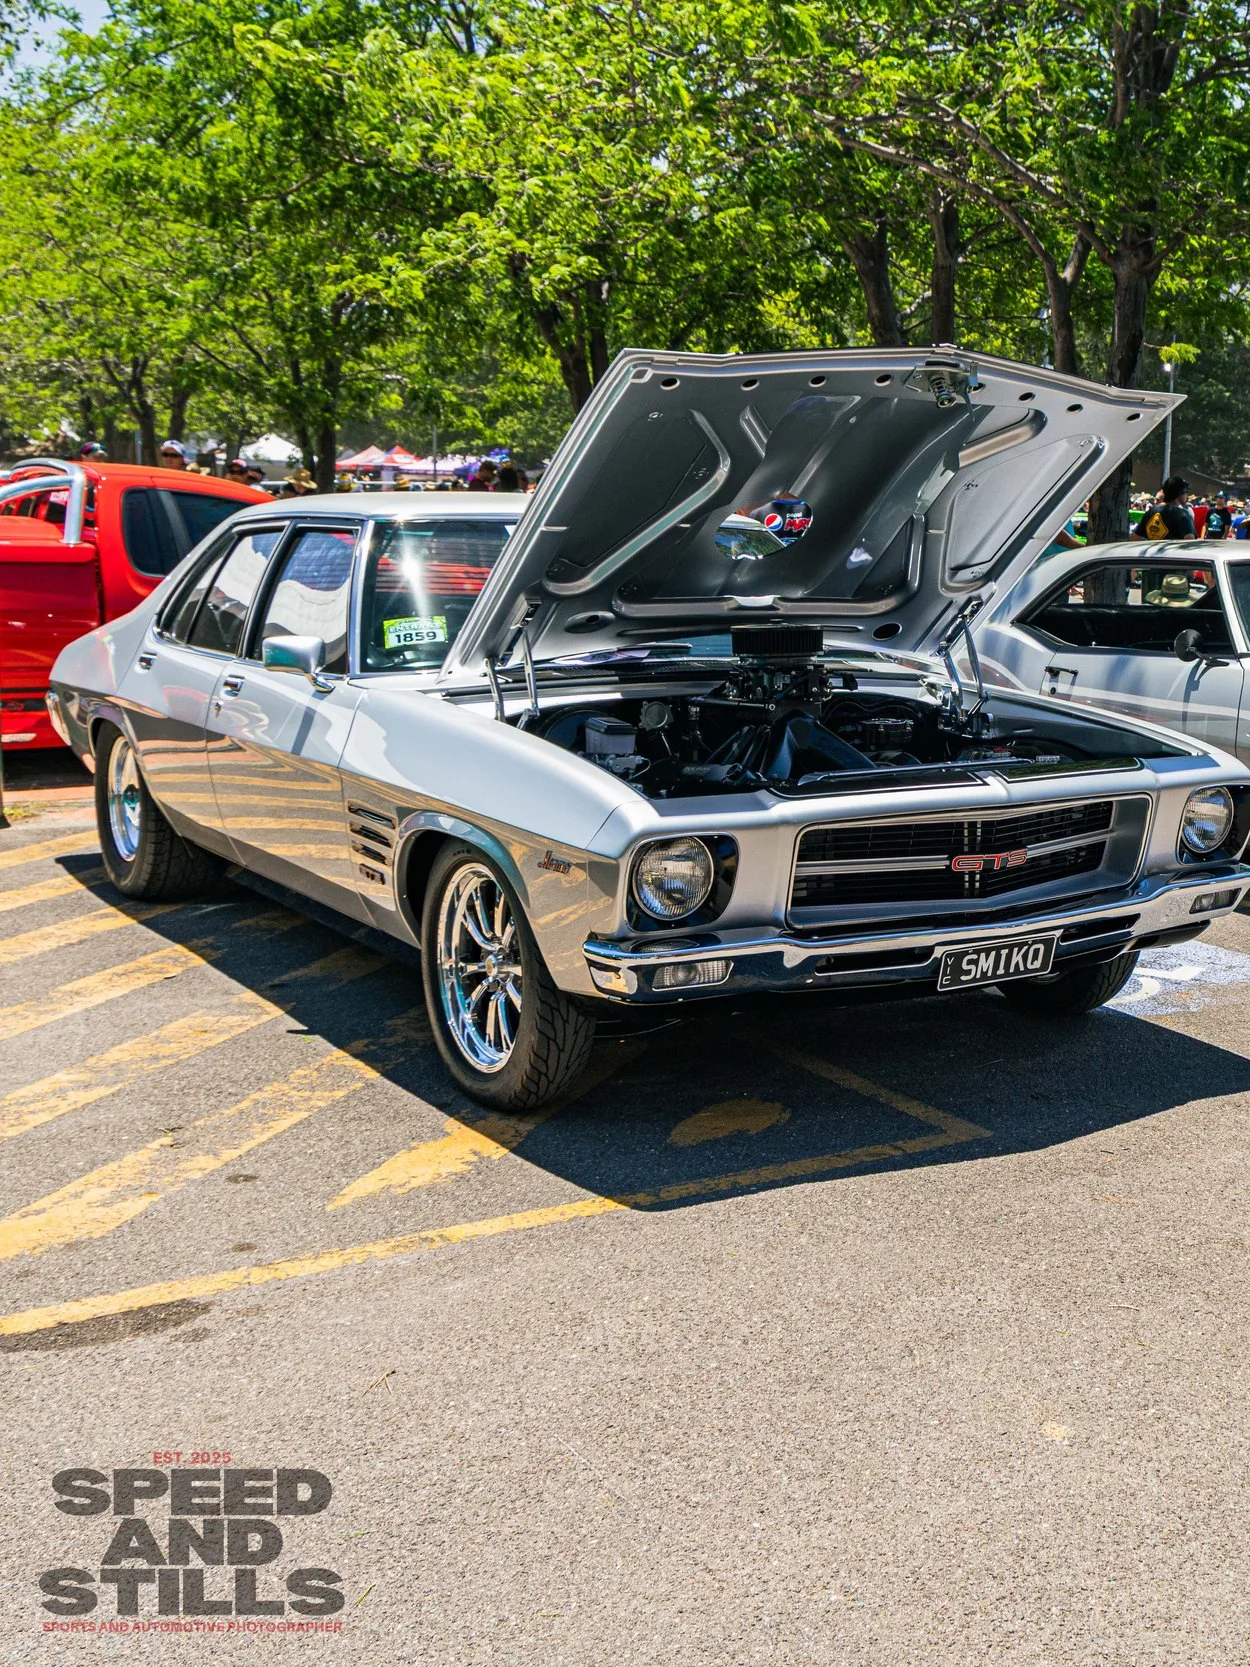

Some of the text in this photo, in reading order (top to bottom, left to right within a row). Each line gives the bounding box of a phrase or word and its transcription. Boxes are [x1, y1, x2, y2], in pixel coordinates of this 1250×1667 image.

[395, 631, 437, 643] 1859
[951, 849, 1027, 872] GTS
[942, 956, 955, 984] VIC
[960, 943, 1045, 981] SMIKQ
